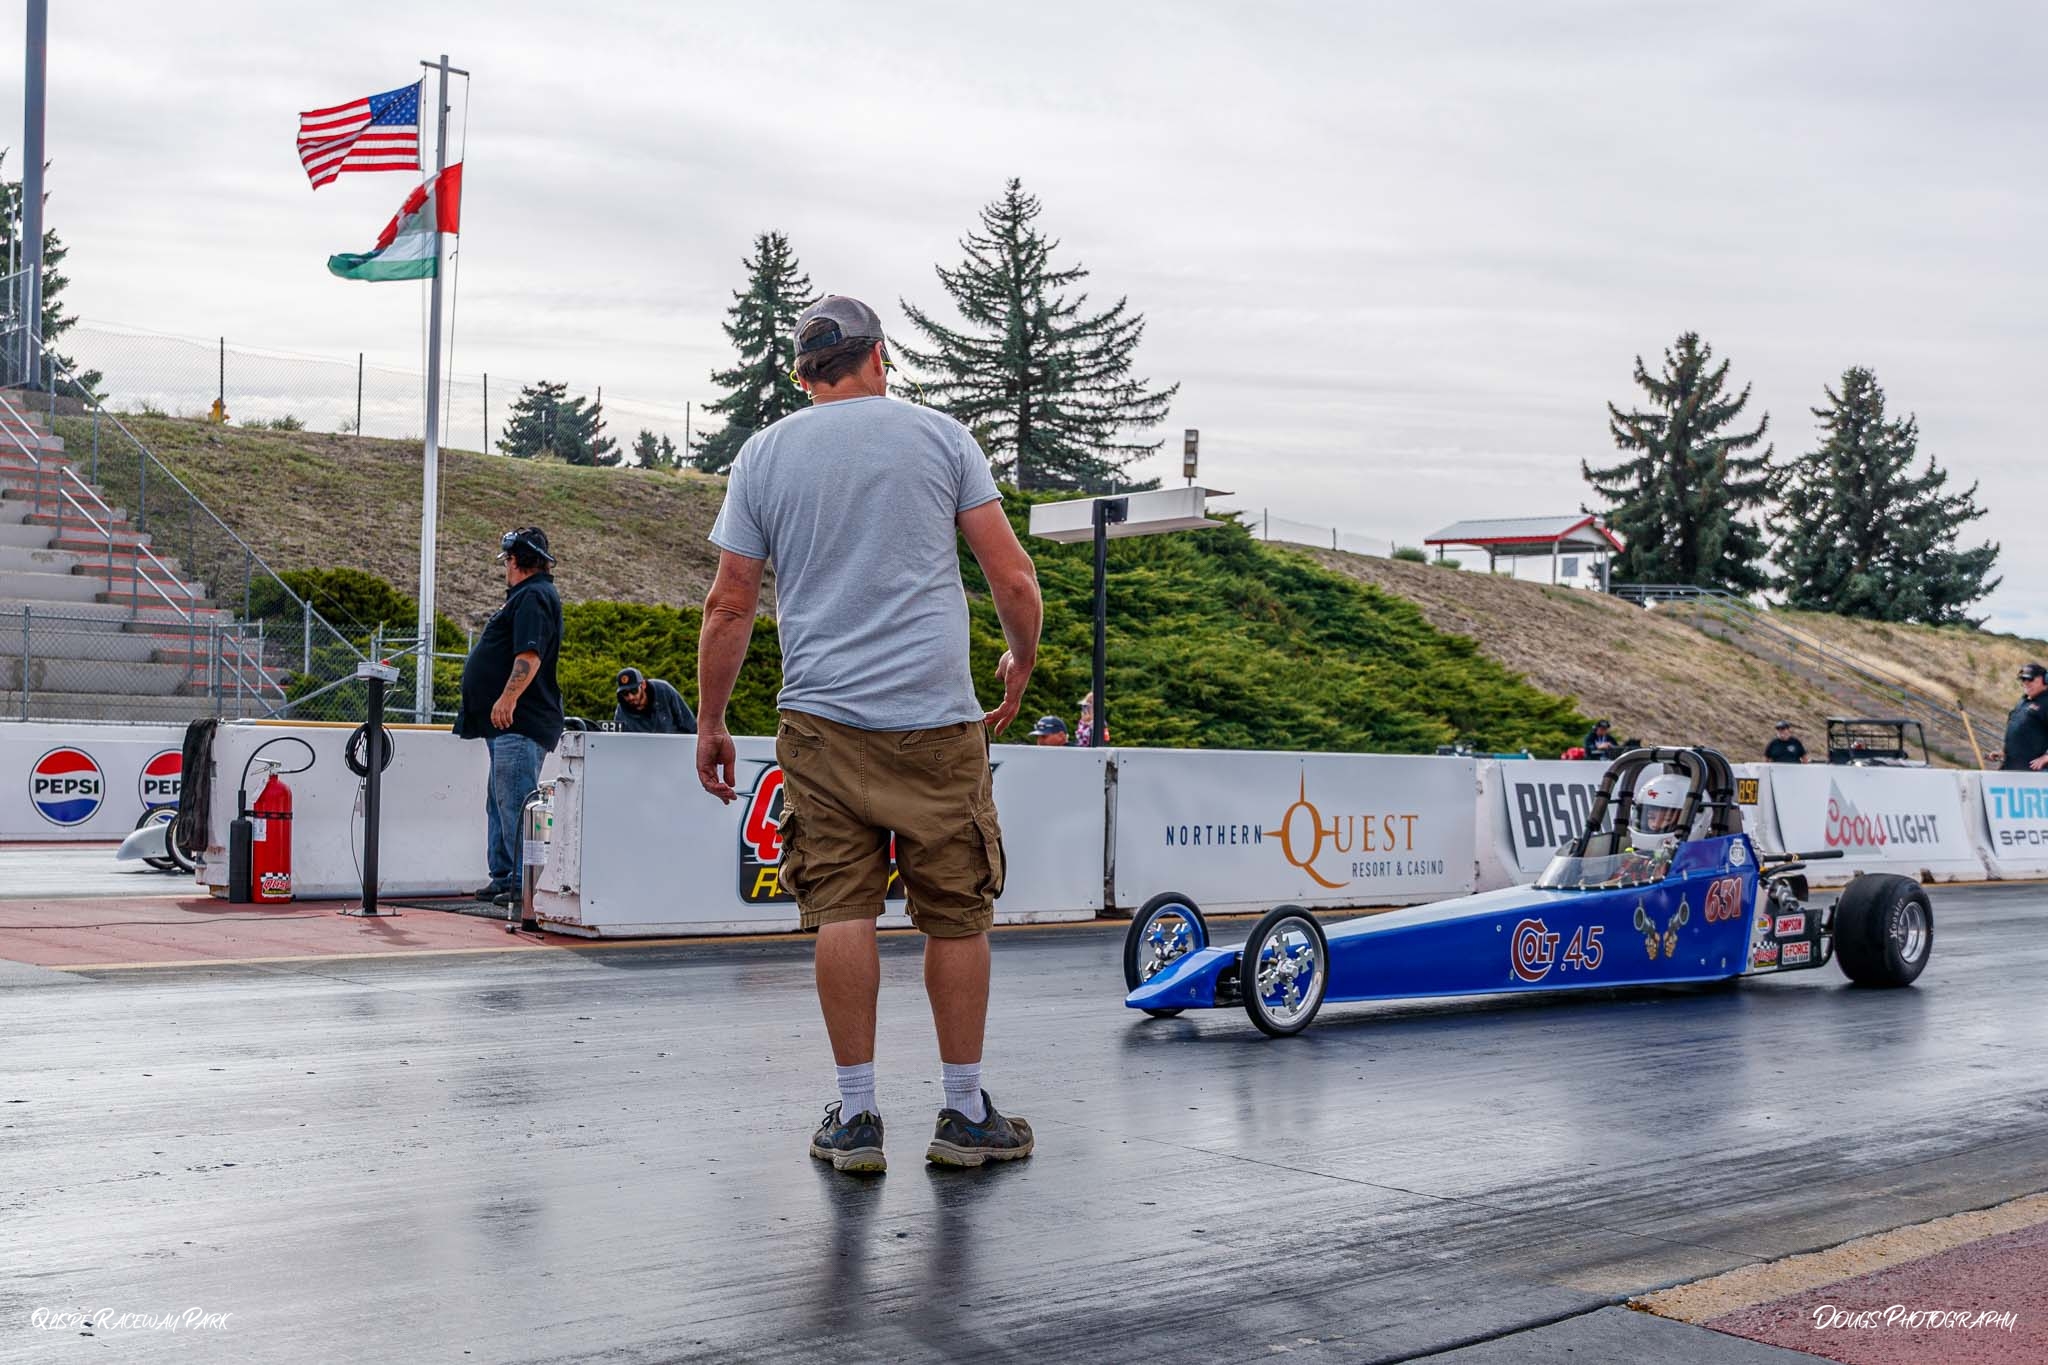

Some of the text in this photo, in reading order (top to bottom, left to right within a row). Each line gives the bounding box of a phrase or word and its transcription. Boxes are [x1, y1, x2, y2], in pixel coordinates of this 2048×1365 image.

[35, 778, 99, 795] PEPSI
[1824, 797, 1939, 847] Coors LIGHT
[1166, 798, 1419, 889] NORTHERN QUEST
[1351, 859, 1443, 878] RESORT & CASINO
[1704, 876, 1742, 922] 631
[1777, 917, 1803, 933] SIMPSON
